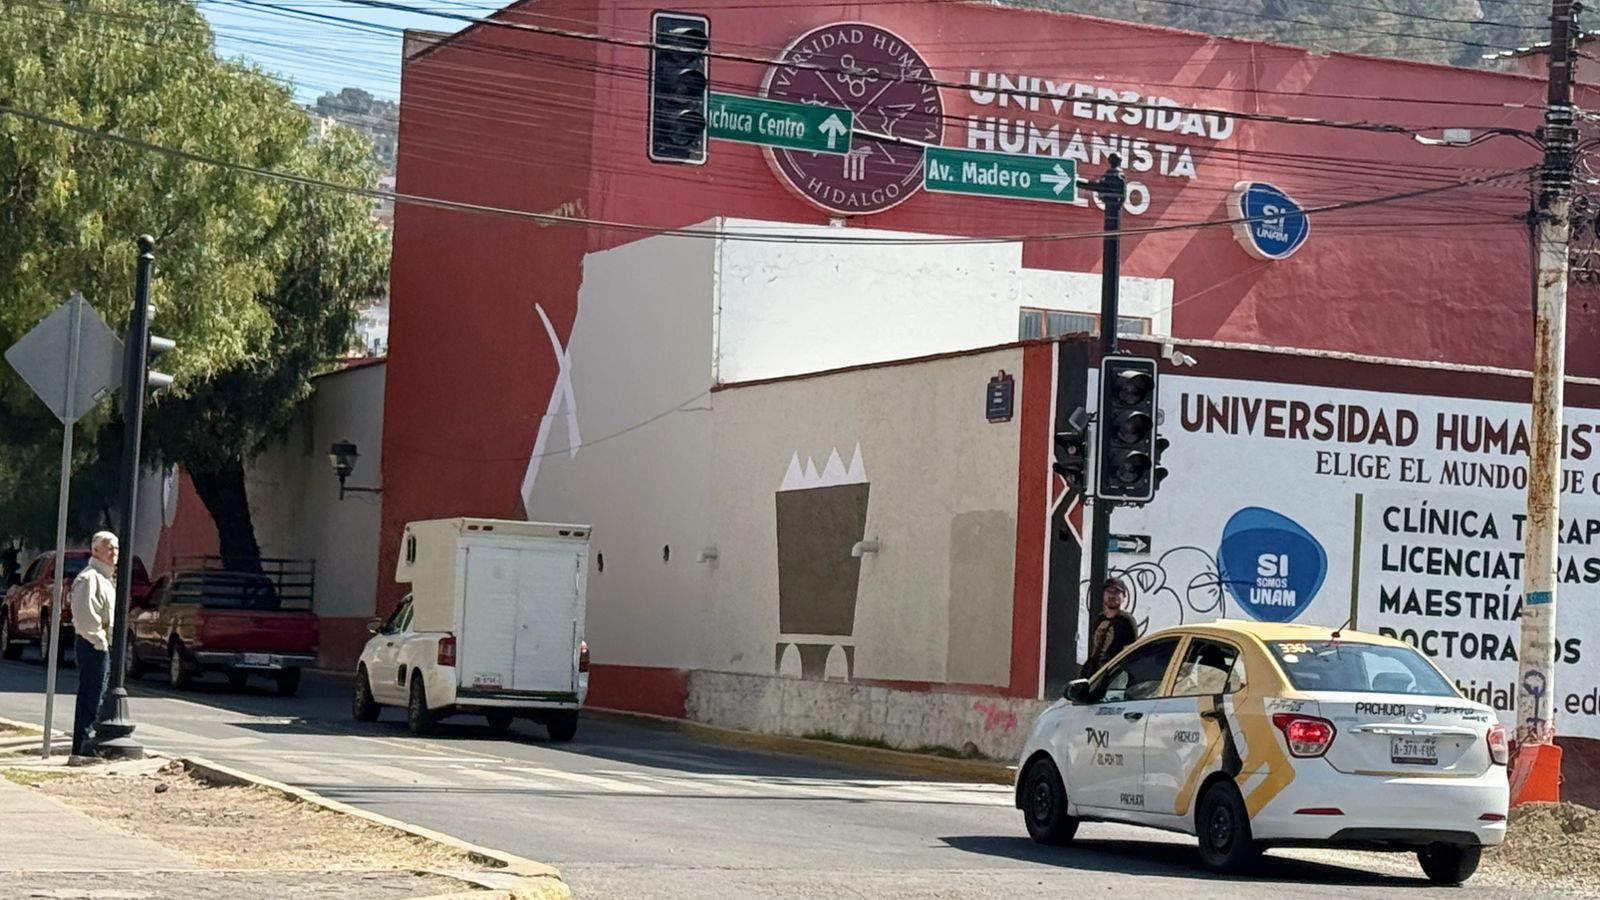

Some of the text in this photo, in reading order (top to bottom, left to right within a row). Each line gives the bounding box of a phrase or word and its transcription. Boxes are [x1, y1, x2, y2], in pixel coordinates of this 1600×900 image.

[968, 69, 1235, 141] UNIVERSIDAD
[758, 112, 805, 138] Centro
[967, 114, 1199, 181] HUMANISTA
[928, 158, 1031, 189] Av. Madero
[807, 177, 900, 207] HIDALGO
[1181, 392, 1600, 461] UNIVERSIDAD HUMAIS
[1316, 450, 1391, 480] ELIGE
[1400, 457, 1431, 483] EL
[1439, 460, 1528, 490] MUNDO
[1382, 500, 1499, 540] CLÍNICA
[1257, 553, 1288, 577] SI
[1250, 587, 1296, 607] UNAM
[1256, 577, 1288, 589] SOMOS
[1355, 702, 1406, 717] PACHUCA
[1085, 727, 1110, 748] TAXI
[1393, 743, 1437, 757] A-374-FUS
